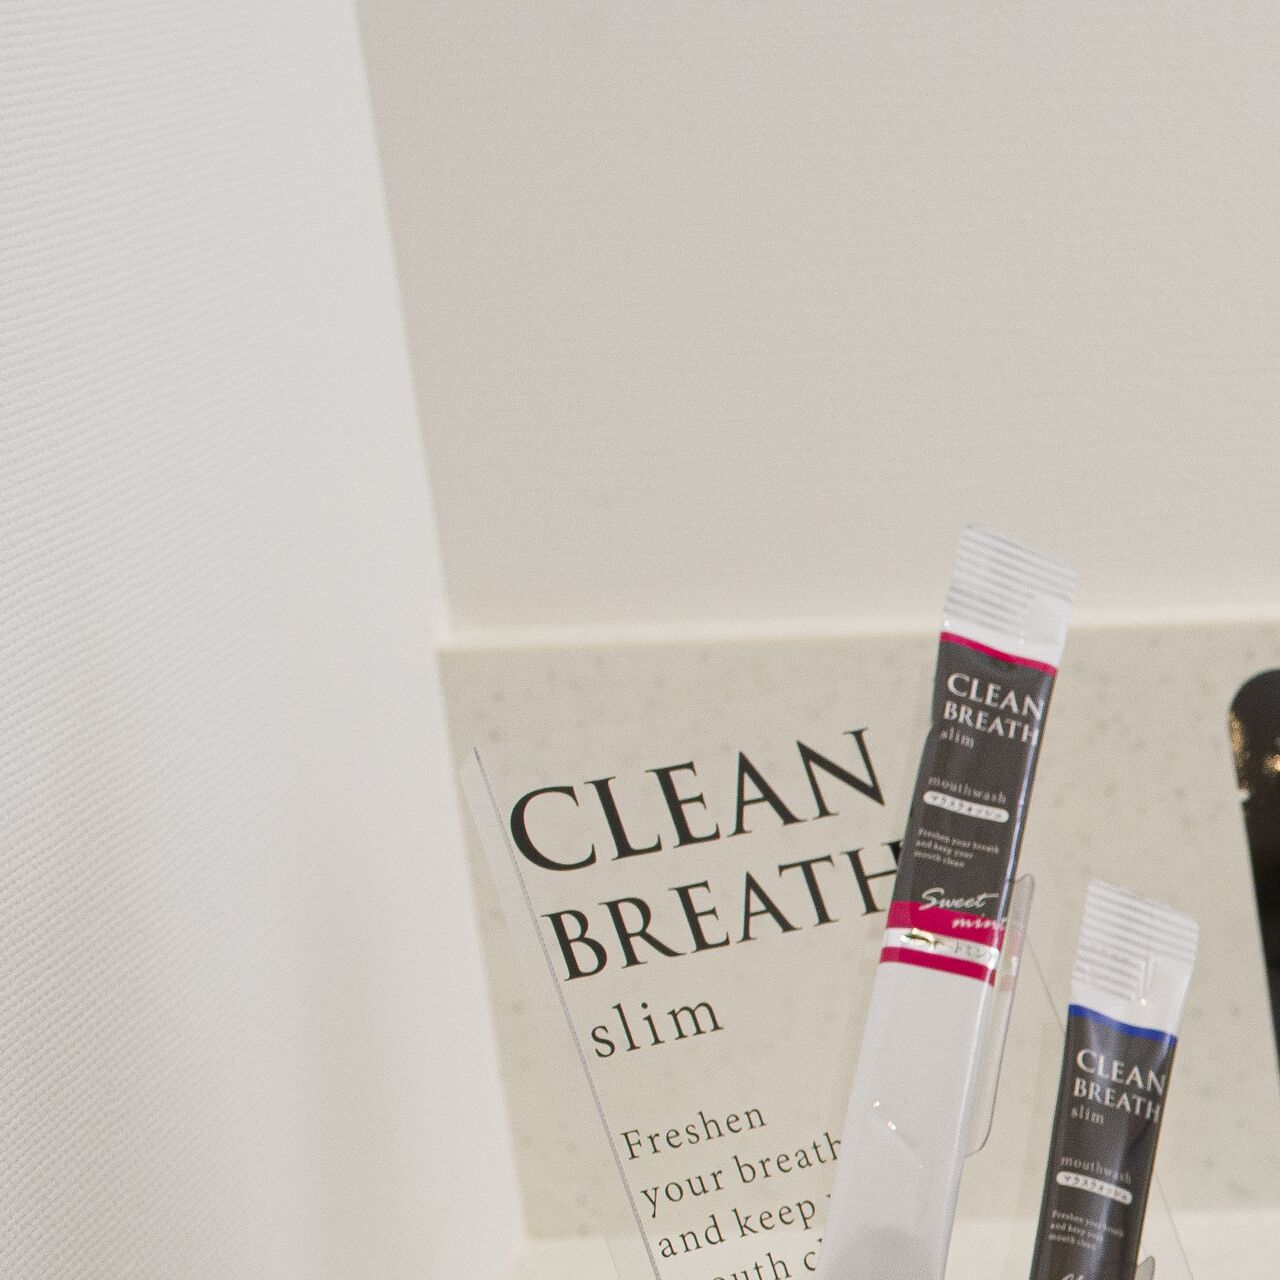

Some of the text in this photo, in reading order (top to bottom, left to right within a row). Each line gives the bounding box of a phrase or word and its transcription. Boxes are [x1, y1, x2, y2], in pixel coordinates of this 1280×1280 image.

[946, 671, 1044, 720] CLEAN
[940, 728, 975, 749] slim
[943, 699, 1040, 746] BREATH
[510, 728, 886, 872] CLEAN
[927, 773, 1007, 804] mouthwash
[541, 841, 901, 982] BREATH
[918, 886, 998, 911] Sweet
[591, 1000, 724, 1058] slim
[1076, 1048, 1166, 1096] CLEAN
[1071, 1107, 1105, 1125] slim
[1074, 1078, 1161, 1124] BREATH
[622, 1104, 767, 1160] Freshen
[641, 1168, 724, 1218] your
[659, 1194, 817, 1258] and keep
